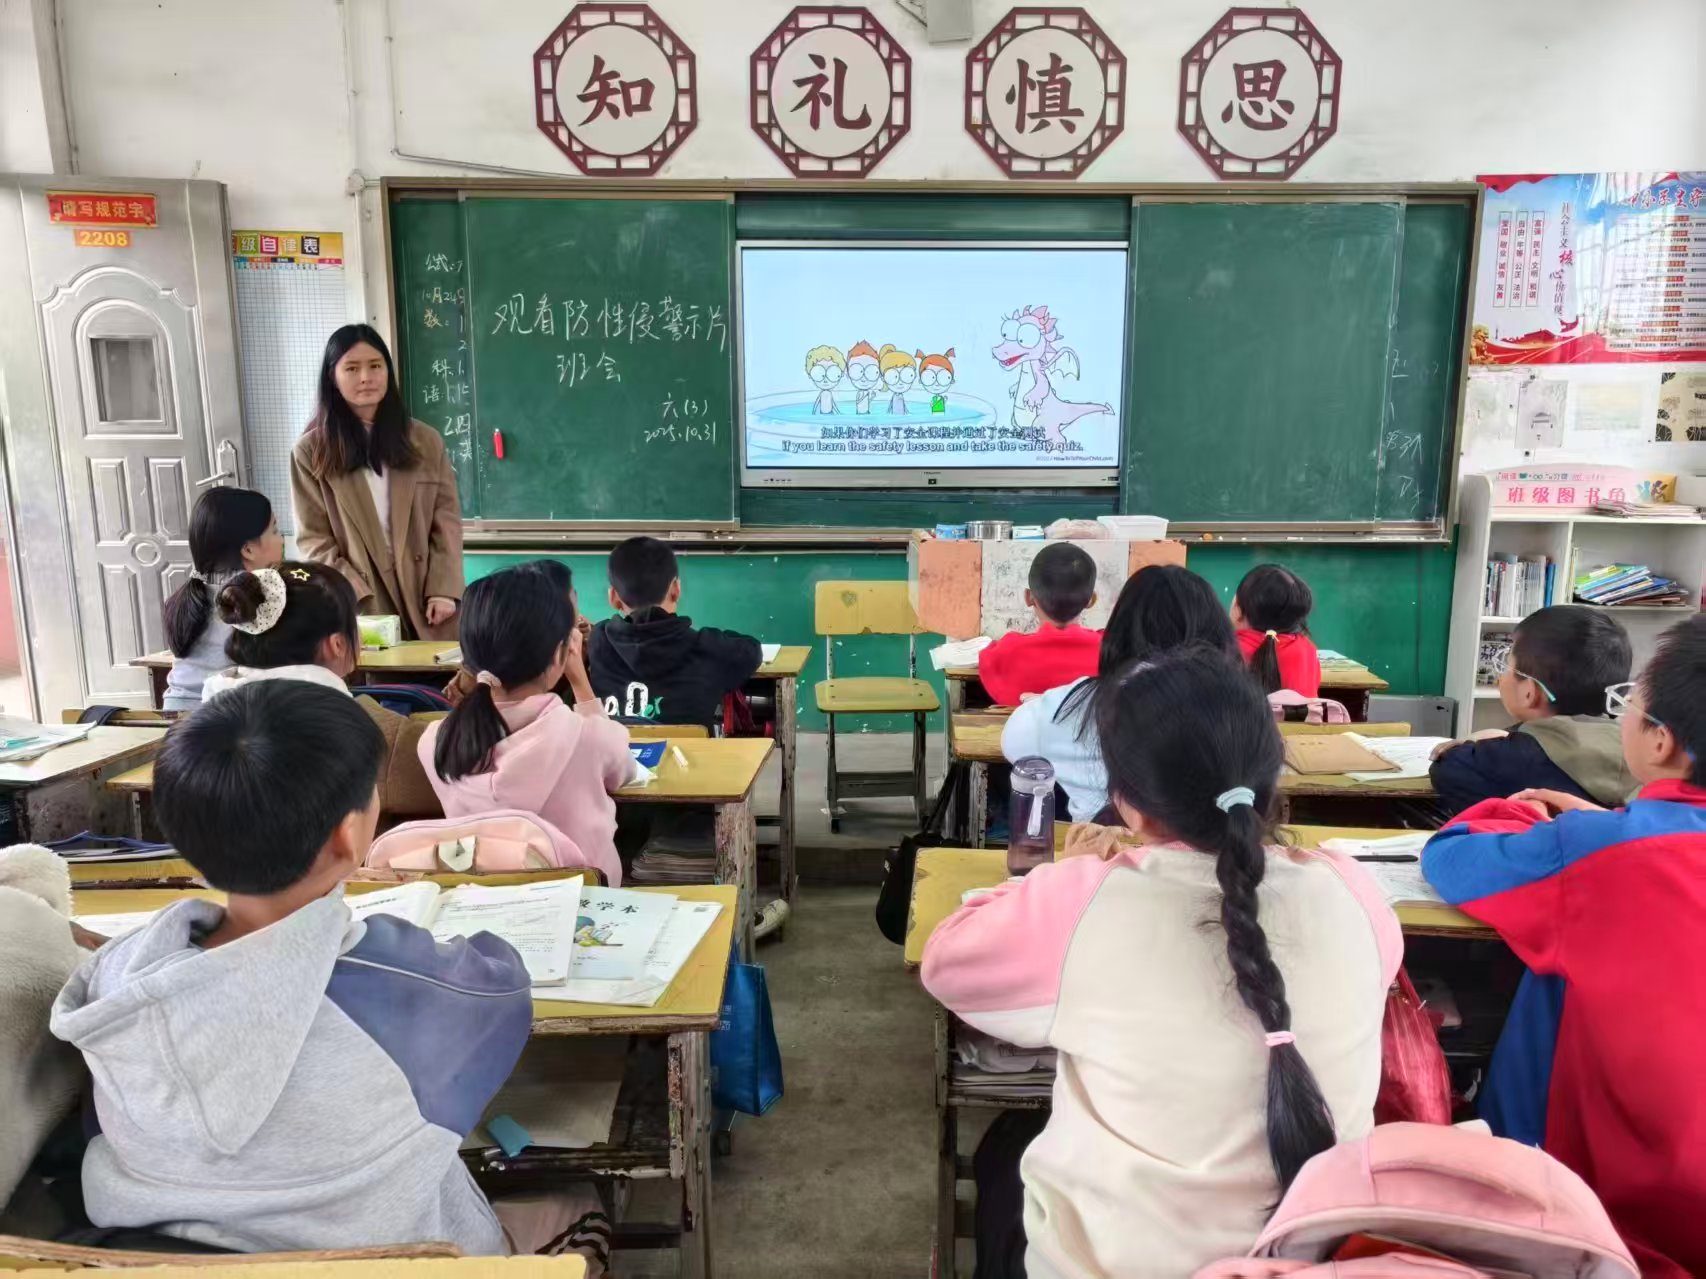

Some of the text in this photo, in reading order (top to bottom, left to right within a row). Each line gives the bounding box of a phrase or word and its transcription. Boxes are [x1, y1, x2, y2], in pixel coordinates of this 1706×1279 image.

[576, 54, 655, 126] 知
[790, 53, 872, 131] 礼
[1005, 52, 1085, 134] 慎
[1221, 59, 1295, 131] 思
[80, 231, 128, 247] 2208
[491, 293, 727, 353] 观看防性侵警示片
[556, 352, 621, 388] 班会
[792, 442, 815, 454] you
[816, 440, 846, 452] learn
[848, 440, 867, 452] the
[868, 440, 904, 454] safety
[906, 441, 945, 452] lesson
[947, 441, 969, 452] and
[971, 441, 996, 452] take
[997, 441, 1016, 452] the
[1018, 441, 1053, 454] safety
[1057, 441, 1084, 454] quiz.
[1508, 487, 1627, 506] 班级图书角
